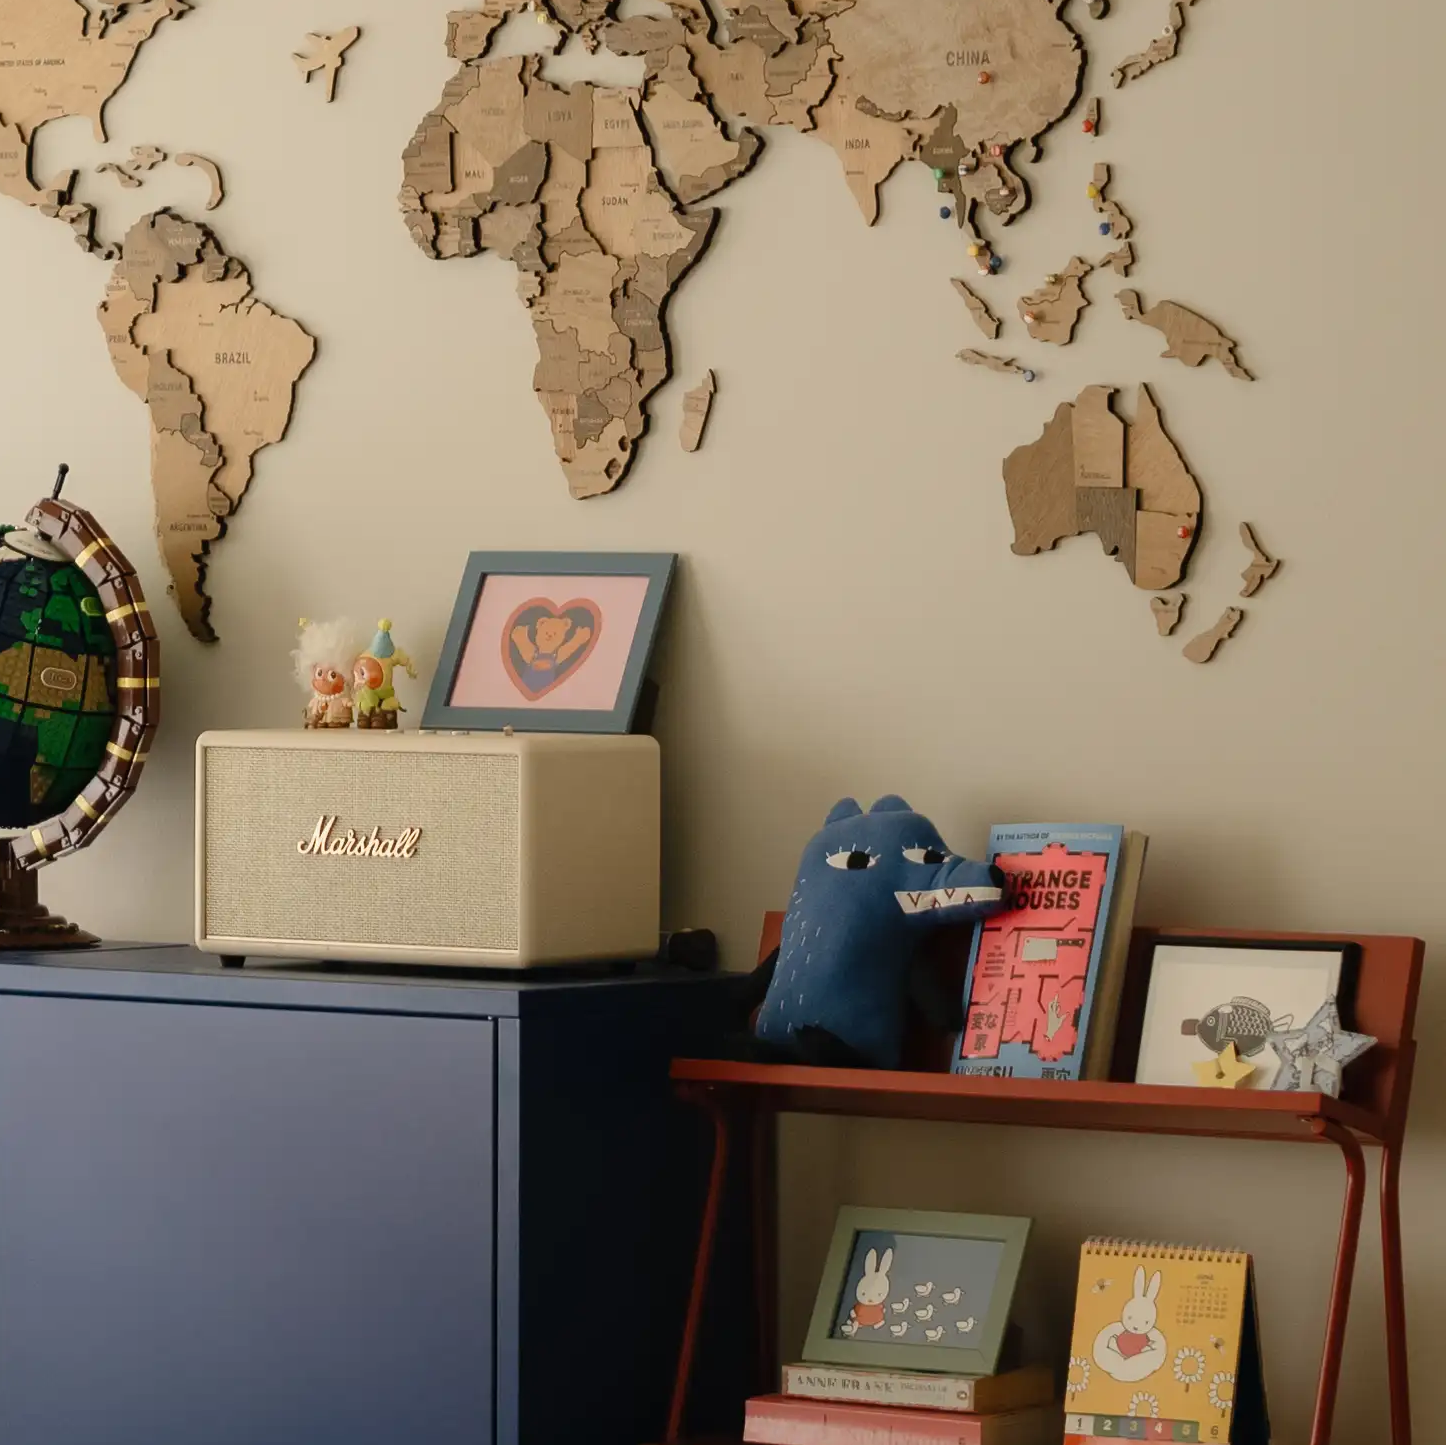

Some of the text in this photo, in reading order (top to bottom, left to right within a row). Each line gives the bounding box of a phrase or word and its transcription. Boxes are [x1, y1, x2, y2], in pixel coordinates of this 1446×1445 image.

[945, 51, 991, 67] CHINA
[603, 119, 631, 130] EGYPT
[844, 139, 871, 150] INDIA
[464, 170, 485, 180] MALI
[601, 197, 629, 207] SUDAN
[109, 334, 127, 344] PERU
[215, 351, 251, 365] BRAZIL
[169, 522, 208, 532] ARGENTINA
[297, 814, 422, 859] Marshall
[1077, 1417, 1219, 1436] 1 2 3 4 5 6
